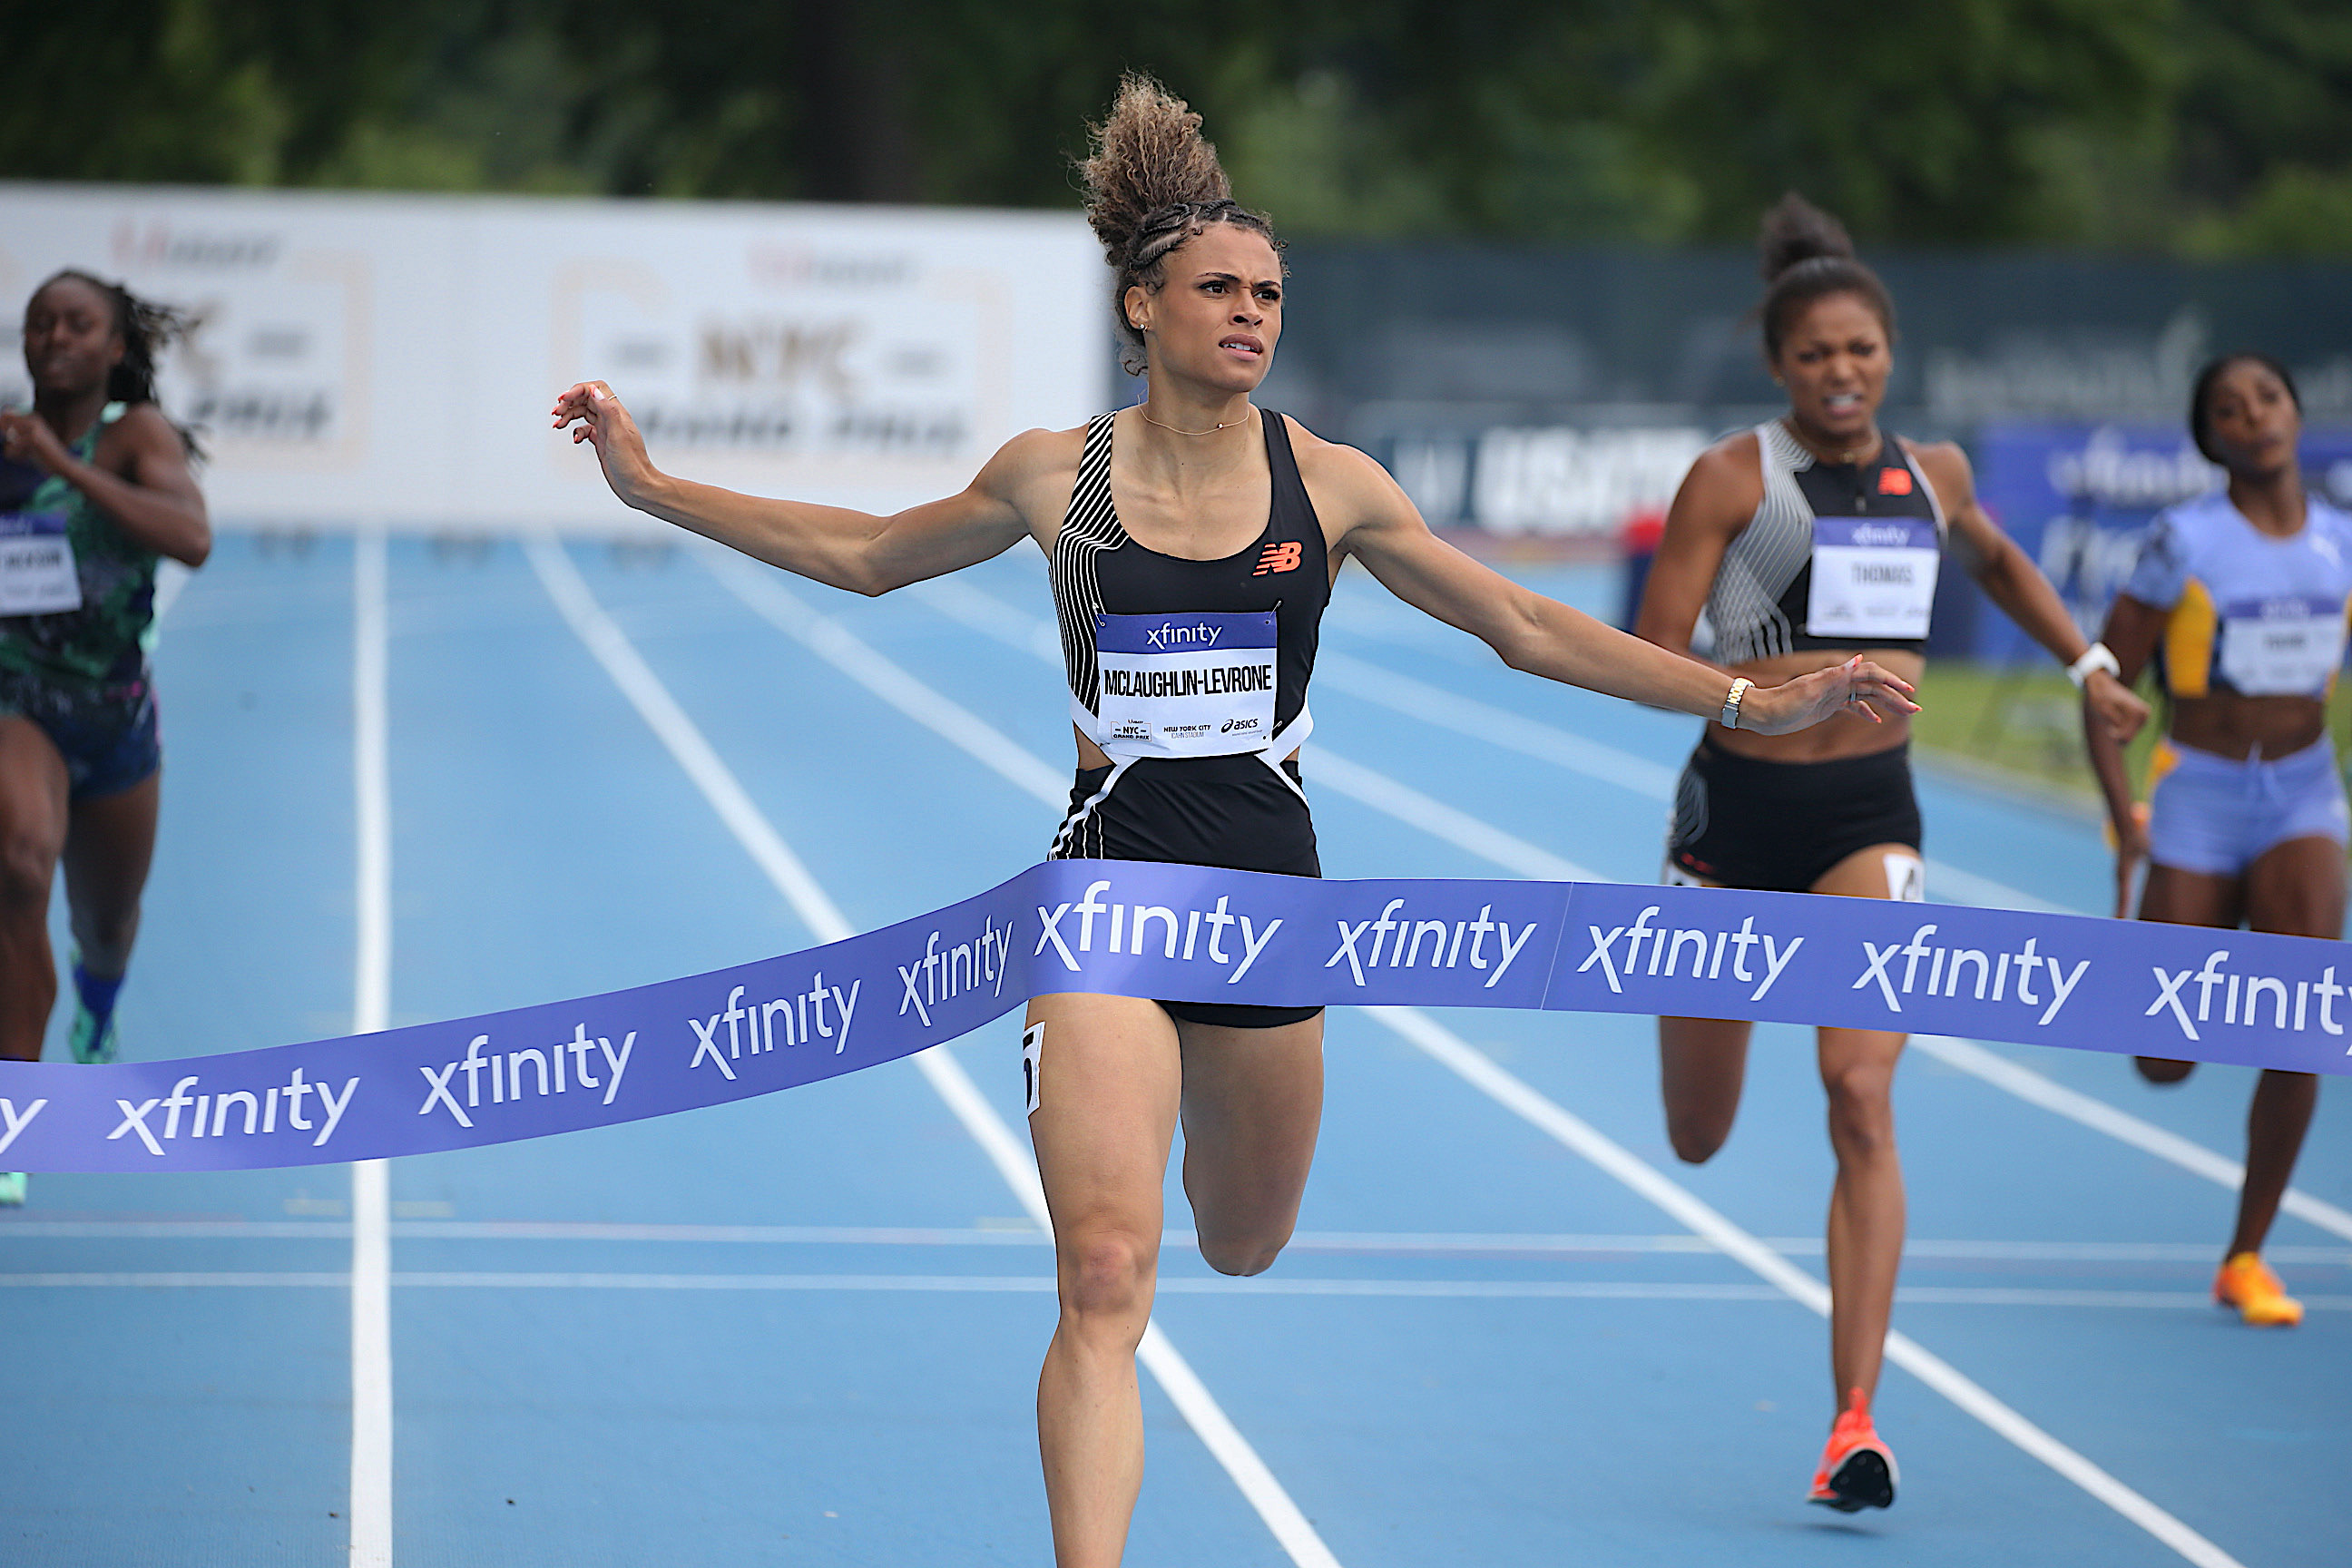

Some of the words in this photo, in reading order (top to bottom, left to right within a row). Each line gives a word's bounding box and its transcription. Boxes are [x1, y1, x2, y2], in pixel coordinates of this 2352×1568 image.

[1146, 622, 1222, 650] xfinity
[1103, 664, 1272, 698] MCLAUGHLIN-LEVRONE
[1122, 726, 1139, 735] NYC
[106, 1067, 361, 1156] xfinity
[418, 1023, 638, 1129] xfinity
[688, 971, 861, 1081] xfinity
[897, 915, 1014, 1027] xfinity
[1034, 880, 1283, 985] xfinity
[1325, 898, 1538, 988] xfinity
[1576, 906, 1805, 1001] xfinity
[1851, 924, 2091, 1025] xfinity
